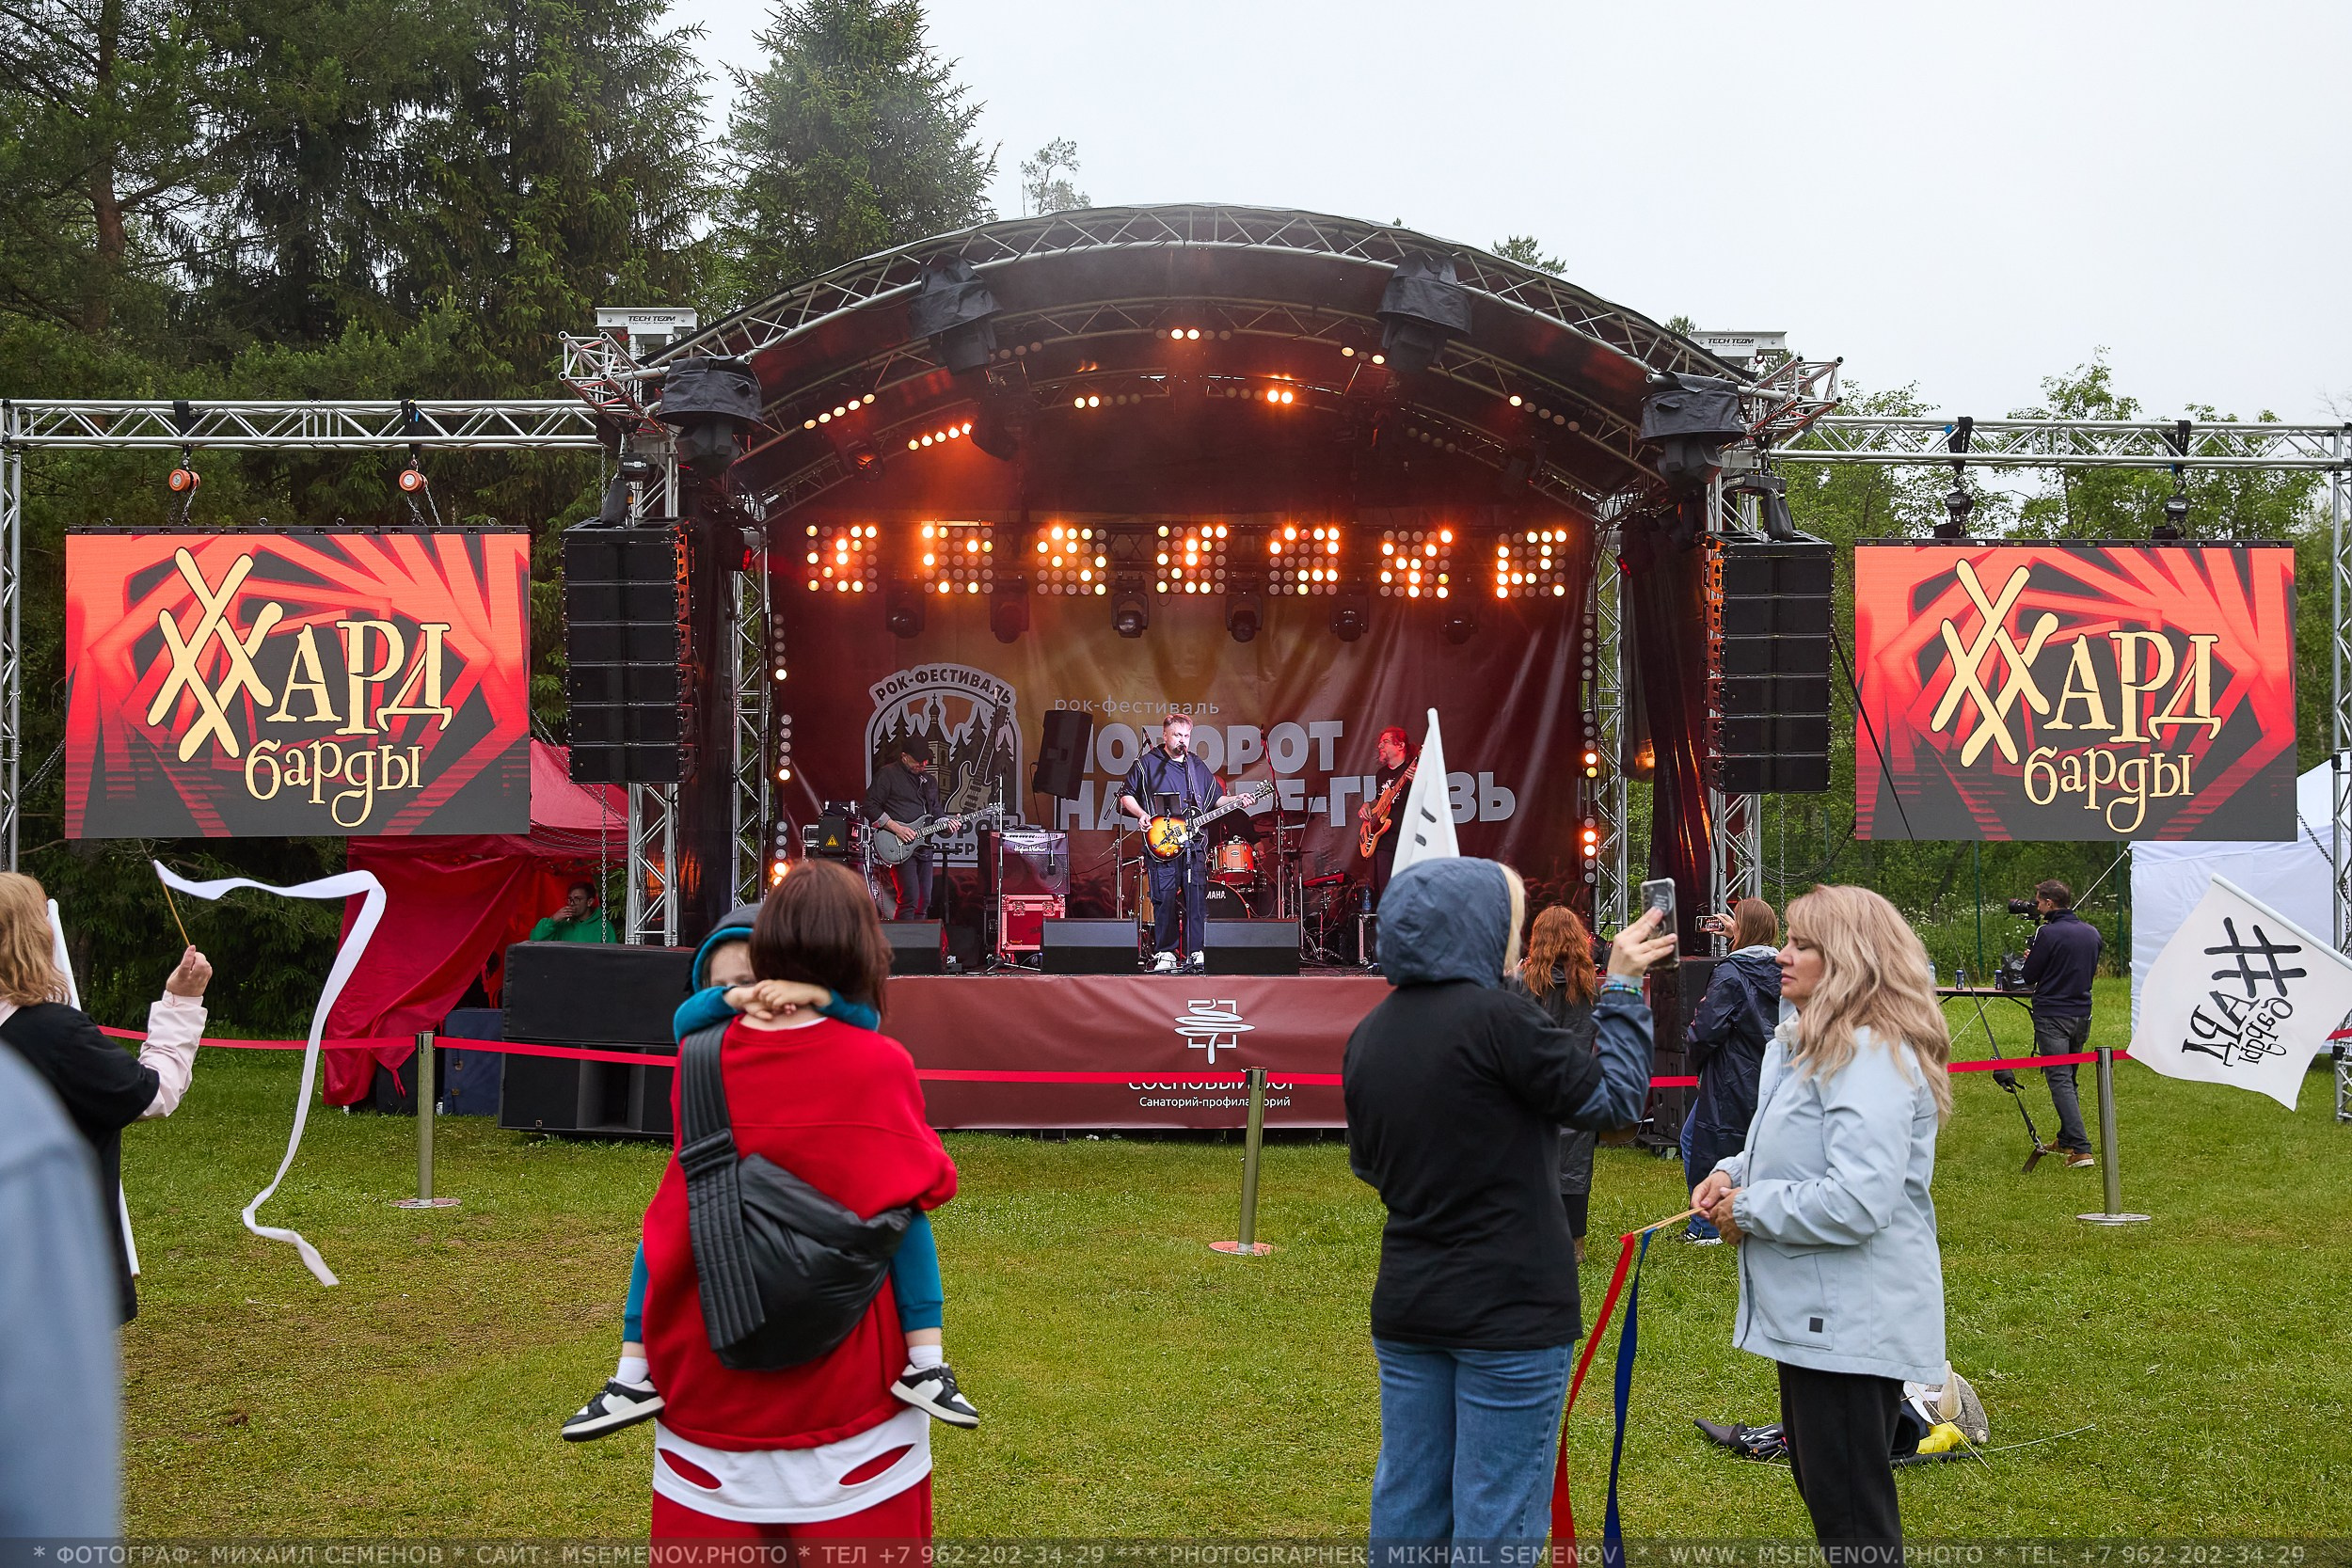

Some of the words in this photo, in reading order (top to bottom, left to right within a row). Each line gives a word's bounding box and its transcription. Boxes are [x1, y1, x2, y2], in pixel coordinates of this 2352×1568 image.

[875, 668, 1011, 705] РОК-ФЕСТИВАЛЬ
[1055, 695, 1219, 717] рок-фестиваль
[245, 738, 424, 828] барды
[2024, 745, 2195, 833] барды
[1139, 1096, 1291, 1109] Санаторий-профилаорий
